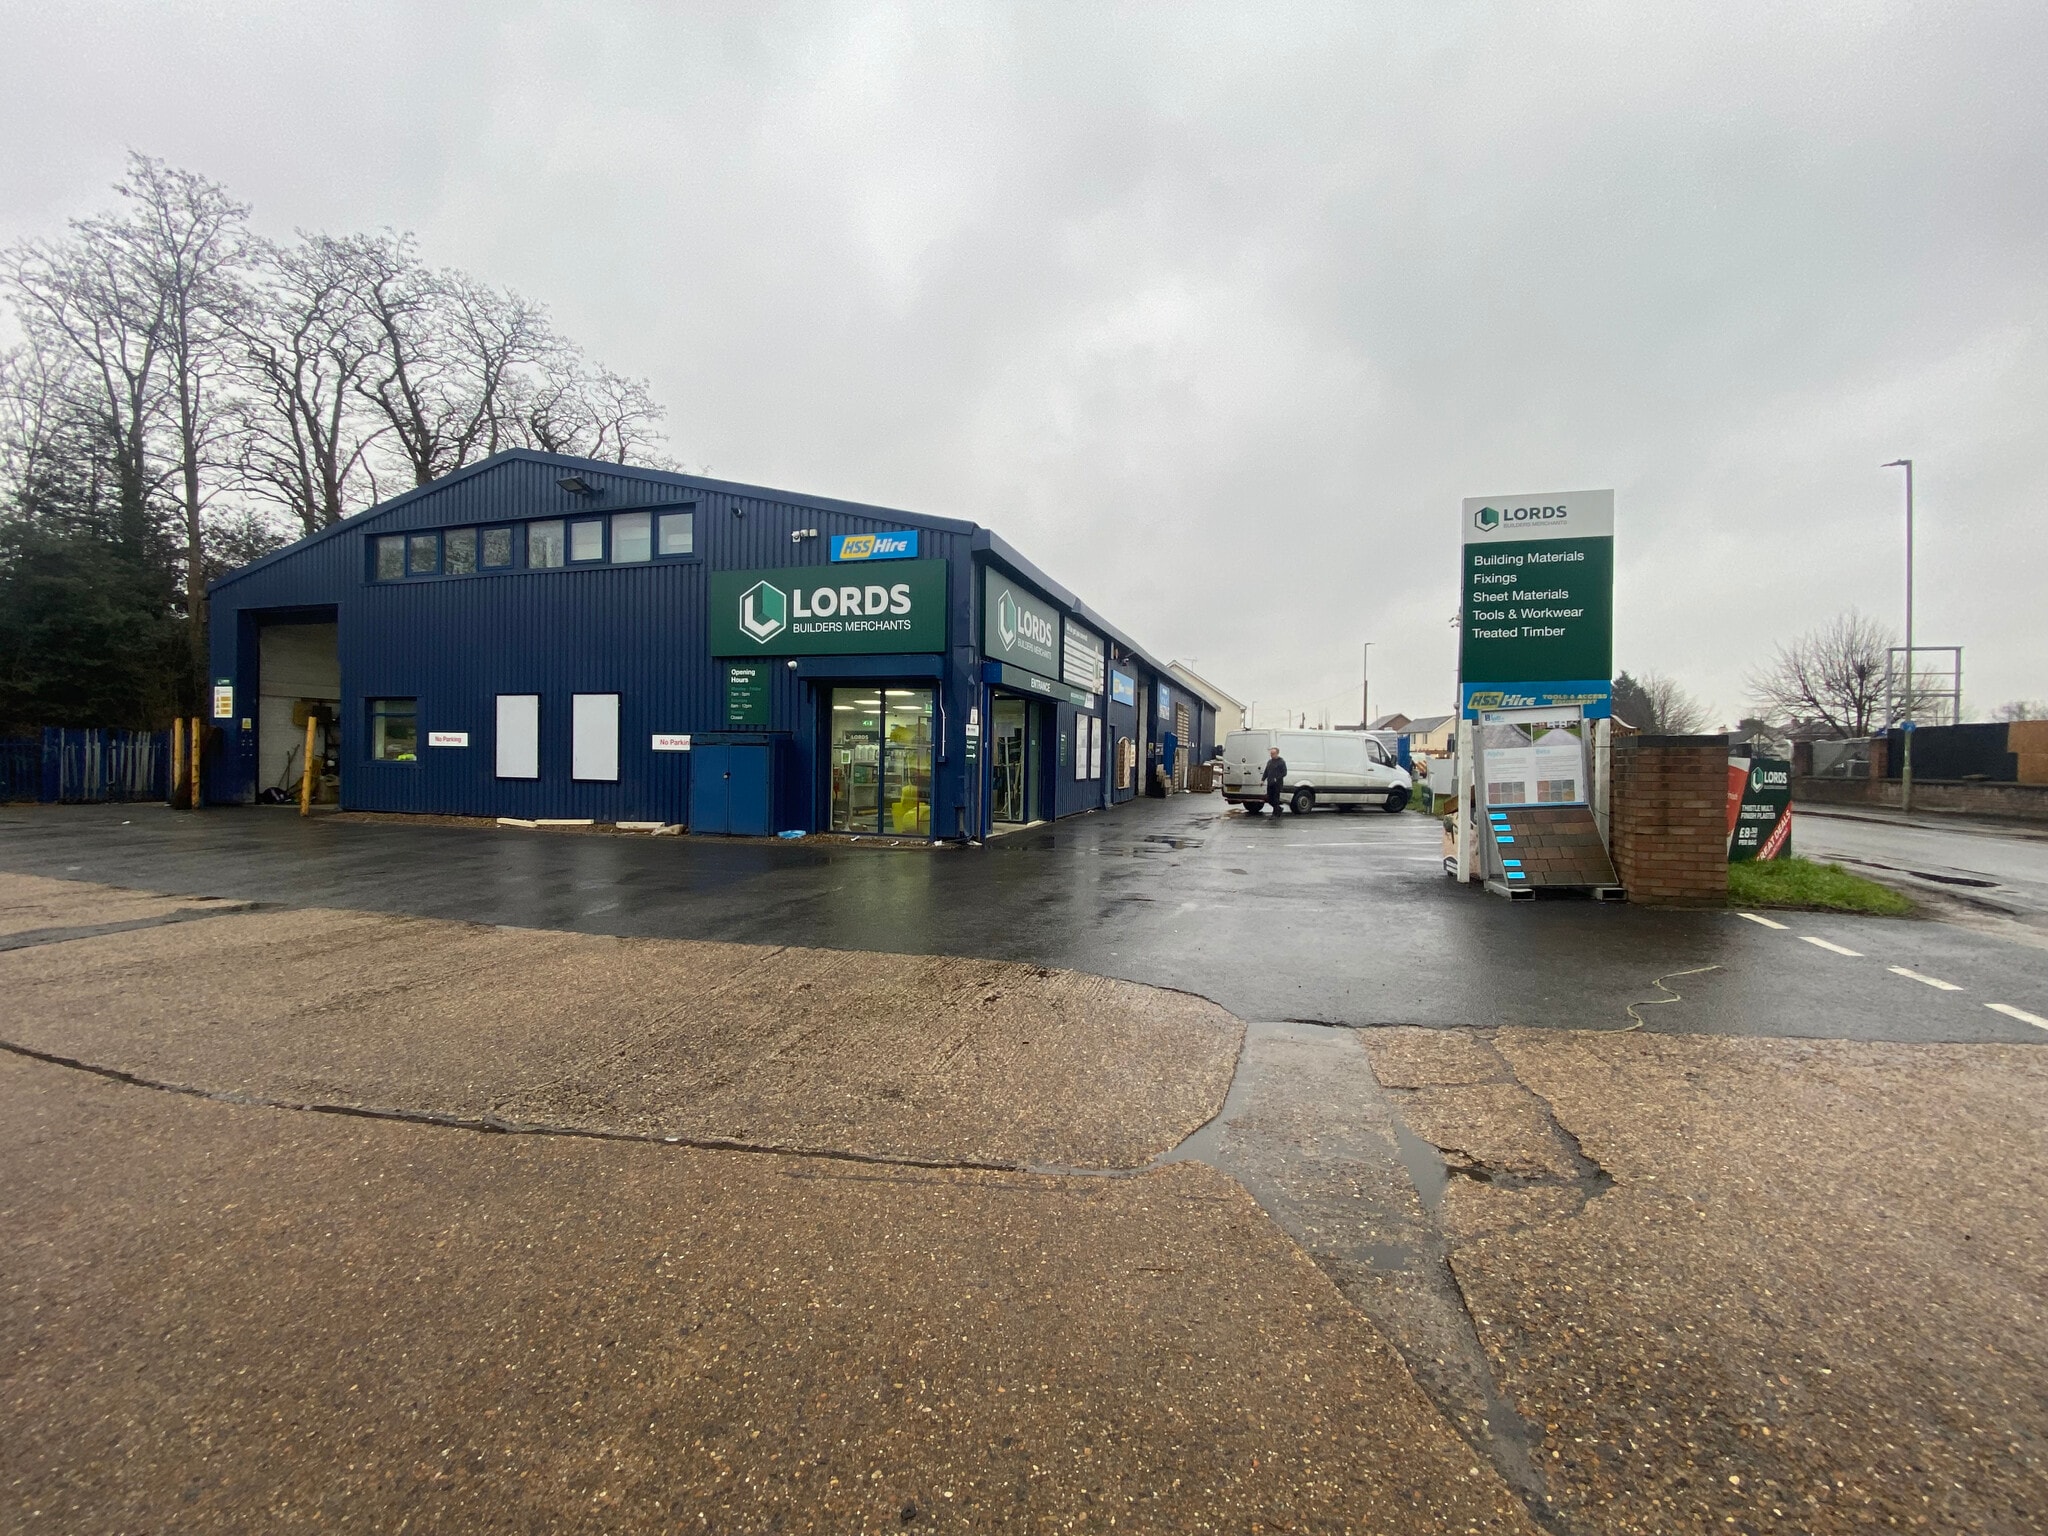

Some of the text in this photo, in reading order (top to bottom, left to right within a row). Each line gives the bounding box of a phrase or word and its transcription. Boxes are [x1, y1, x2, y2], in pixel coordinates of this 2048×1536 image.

[1504, 506, 1567, 521] LORDS
[843, 538, 908, 554] HSS Hire
[1474, 551, 1584, 566] Building Materials
[1474, 573, 1518, 586] Fixings
[793, 584, 912, 618] LORDS
[1473, 589, 1569, 602] Sheet Materials
[1472, 608, 1584, 620] Tools & Workwear
[793, 620, 911, 634] BUILDERS MERCHANTS
[1018, 606, 1052, 648] LORDS
[1472, 626, 1566, 638] Treated Timber
[1030, 678, 1050, 692] ENTRANCE
[1471, 695, 1498, 706] HSS
[1501, 694, 1536, 706] Hire
[1764, 771, 1787, 784] LORDS
[1774, 810, 1791, 838] DEALS
